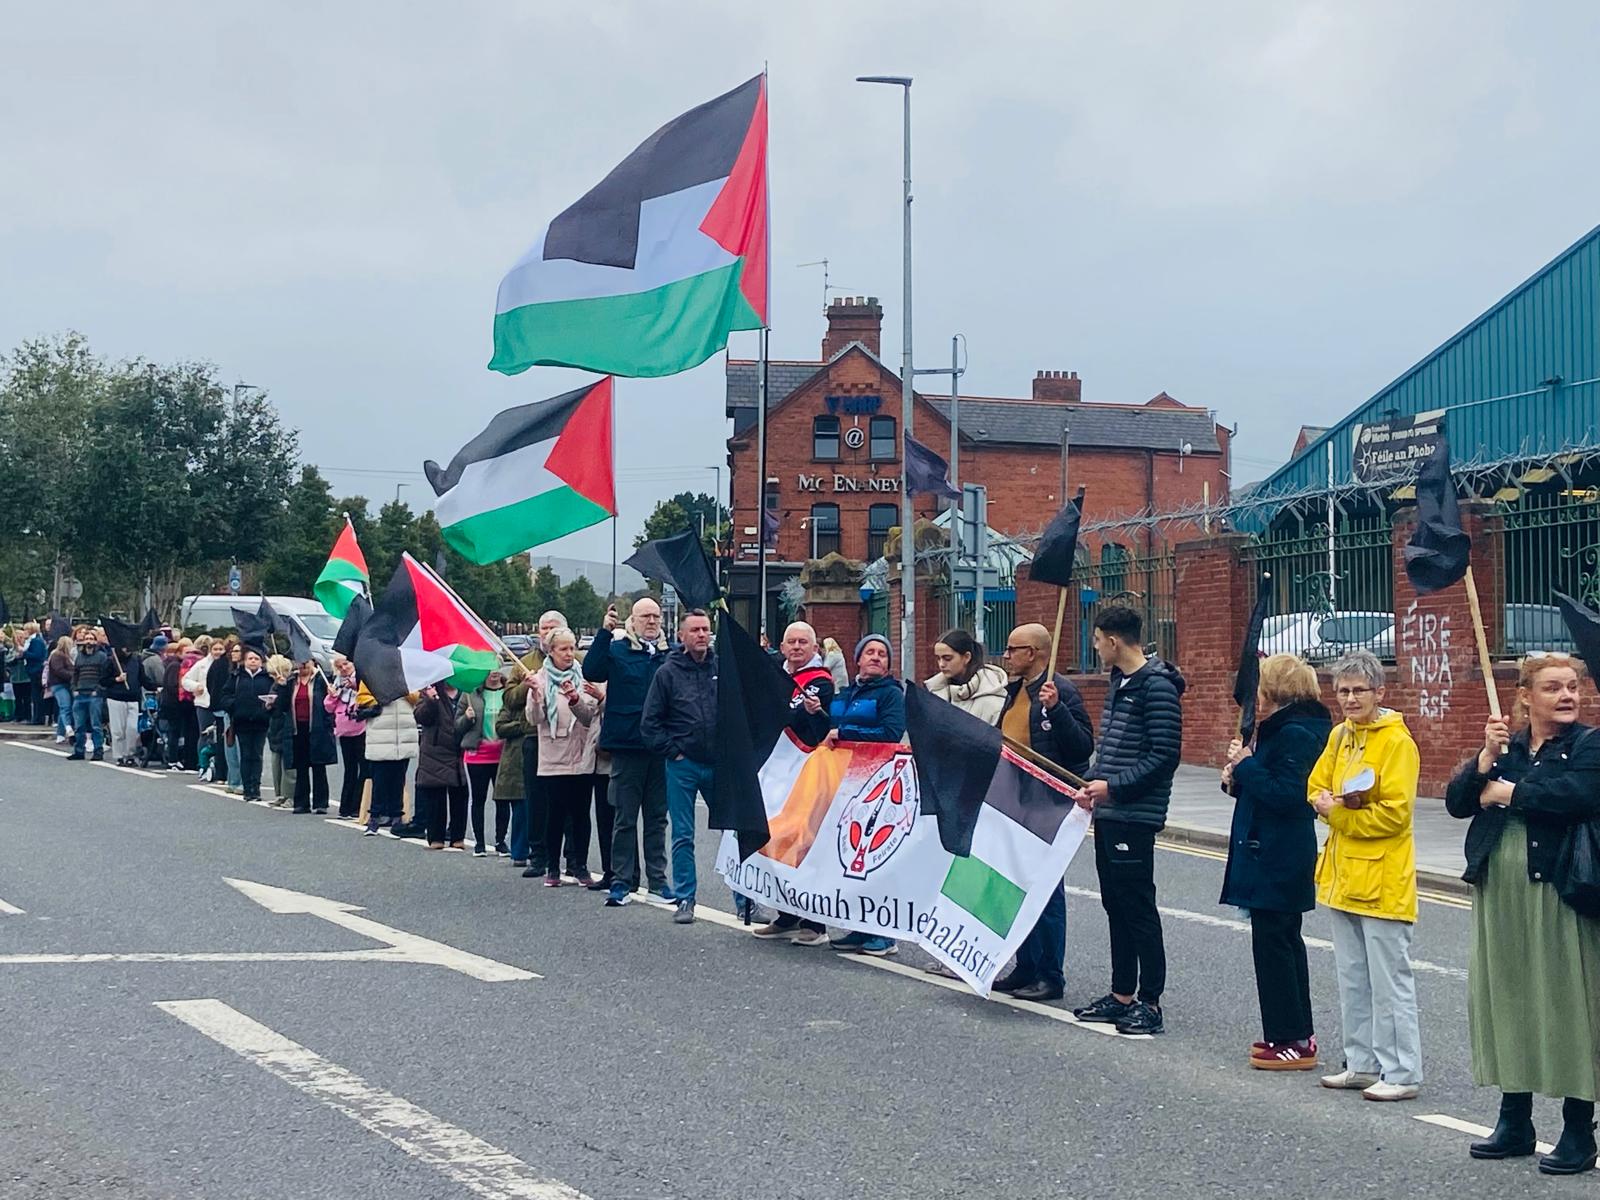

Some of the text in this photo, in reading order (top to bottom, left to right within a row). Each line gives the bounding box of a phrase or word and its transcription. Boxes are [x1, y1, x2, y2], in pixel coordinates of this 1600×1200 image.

[1372, 442, 1437, 464] Féile an Phoba
[1402, 600, 1450, 652] ÉIRE
[1411, 651, 1453, 689] NUA
[744, 863, 772, 899] CLG
[775, 876, 851, 921] Naomh
[858, 895, 899, 929] Pól
